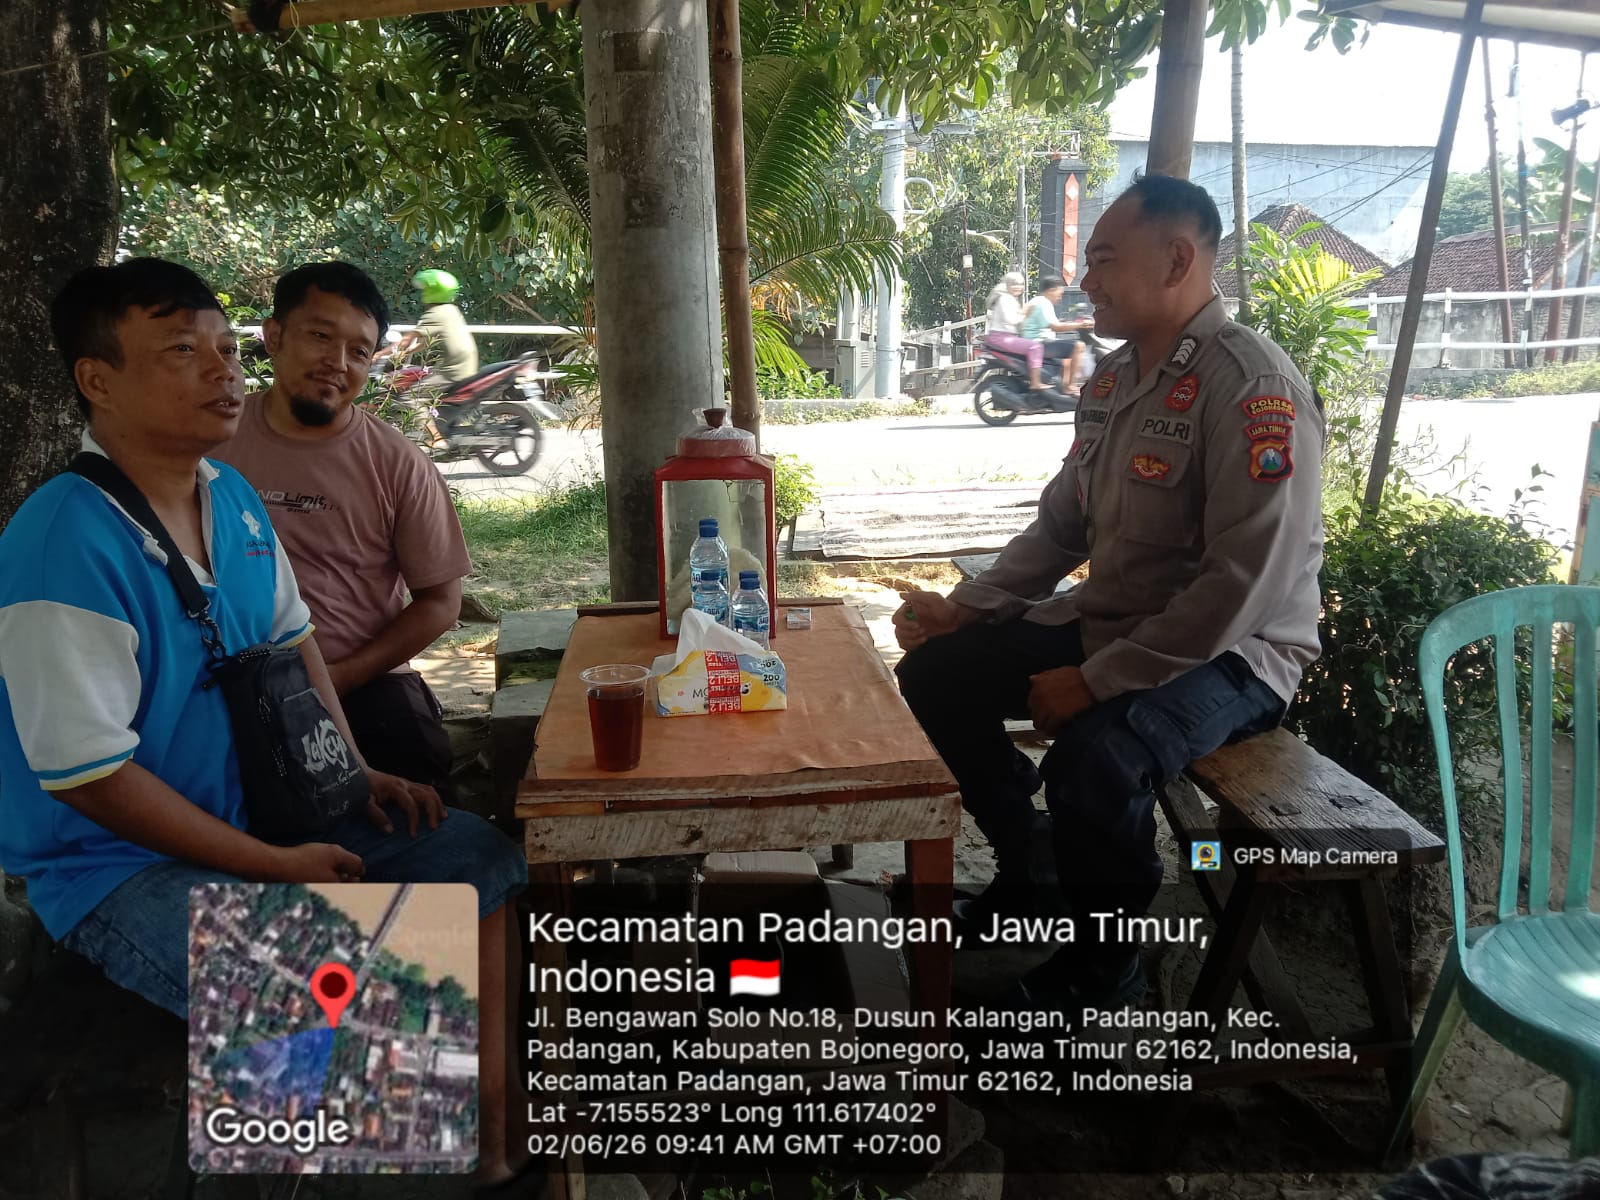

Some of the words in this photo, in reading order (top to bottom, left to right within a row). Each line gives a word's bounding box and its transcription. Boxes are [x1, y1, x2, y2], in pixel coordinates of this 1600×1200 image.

[1141, 419, 1190, 441] POLRI
[709, 676, 716, 685] 2
[763, 674, 780, 682] 200
[709, 703, 716, 712] 2
